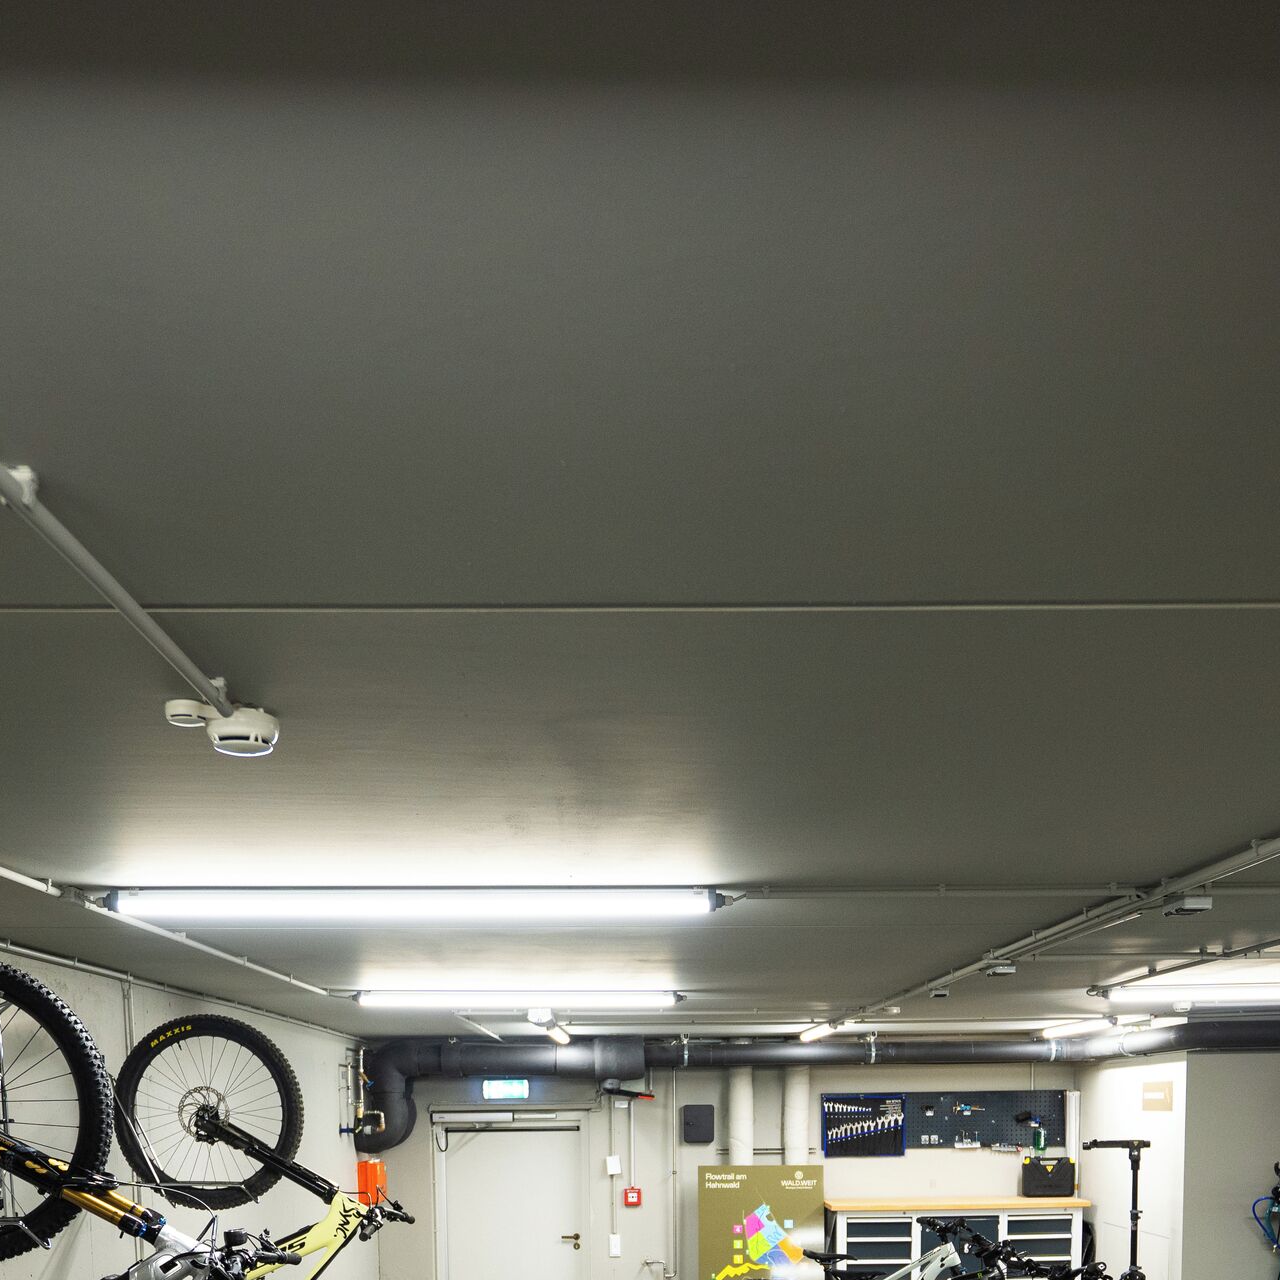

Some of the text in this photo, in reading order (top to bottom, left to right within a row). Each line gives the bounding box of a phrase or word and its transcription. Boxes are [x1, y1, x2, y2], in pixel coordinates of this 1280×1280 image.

[150, 1025, 192, 1048] MAXXIS
[705, 1172, 734, 1181] Flowtrail
[705, 1181, 740, 1189] Hahnwald
